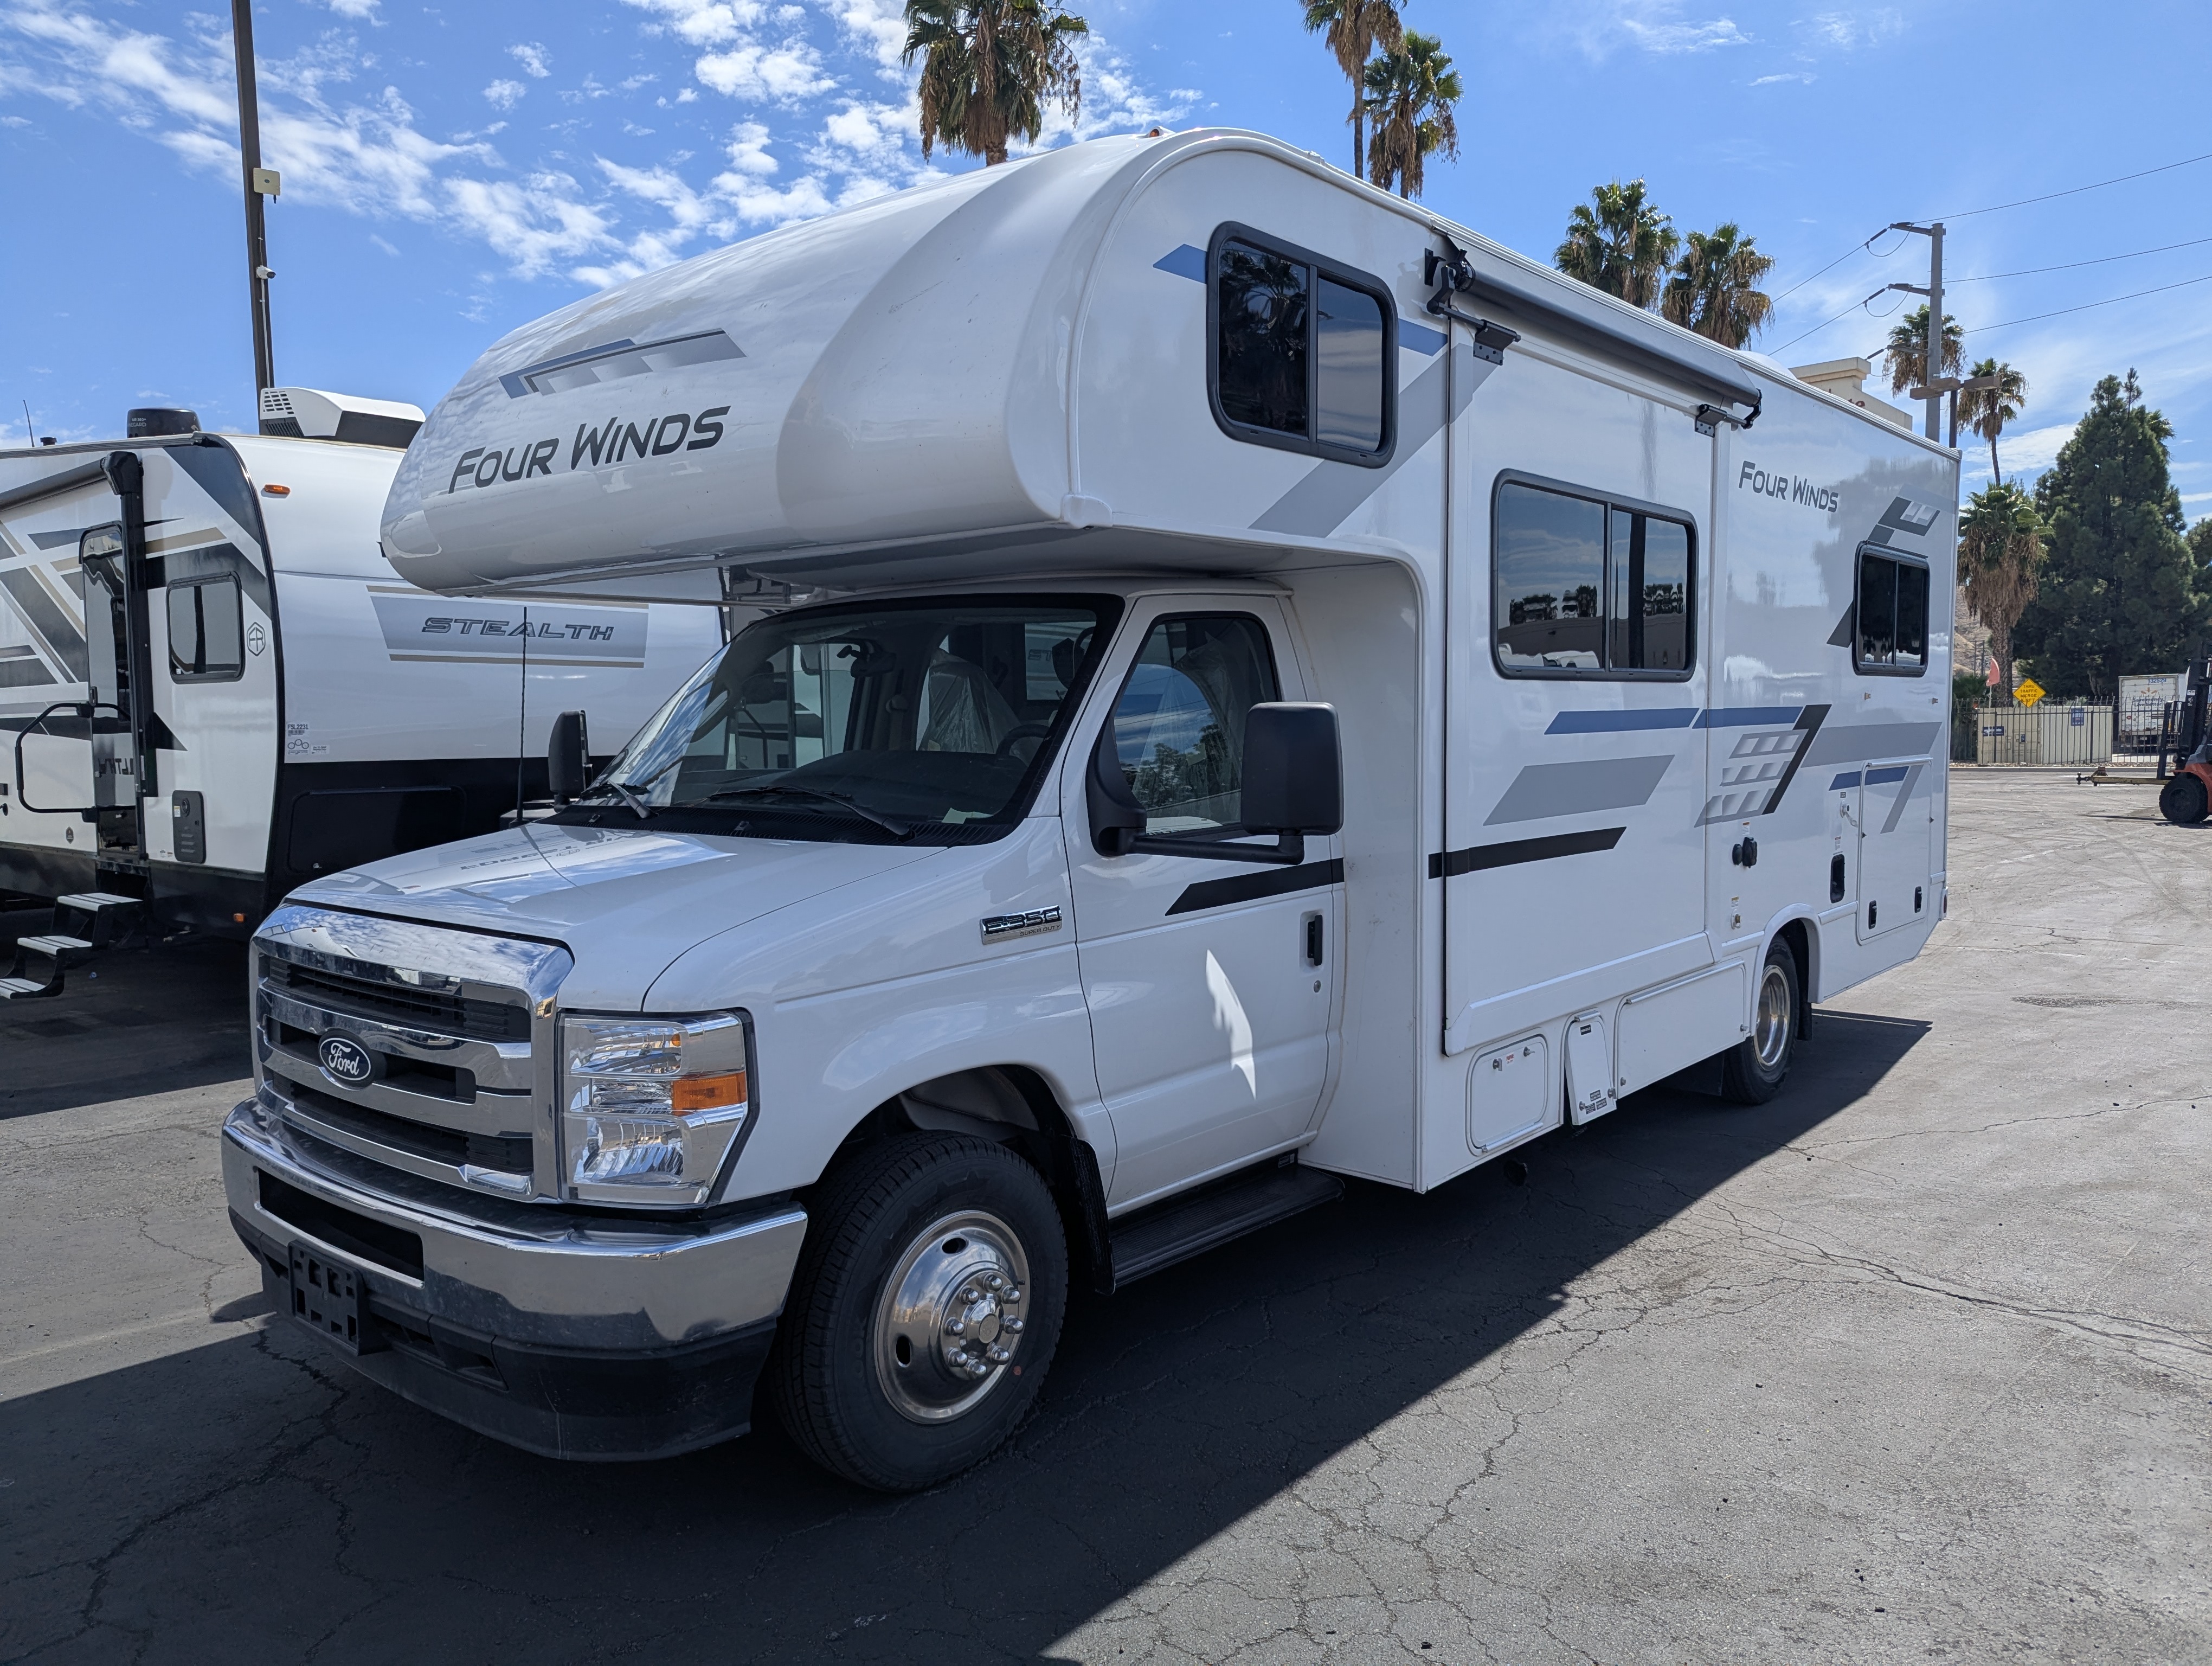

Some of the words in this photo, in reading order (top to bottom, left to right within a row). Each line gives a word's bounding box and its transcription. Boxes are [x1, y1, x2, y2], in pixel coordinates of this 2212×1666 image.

[448, 438, 560, 494] FOUR
[570, 406, 731, 470] WINDS
[1738, 460, 1788, 500] FOUR
[1792, 475, 1839, 513] WINDS
[422, 617, 614, 640] STEALTH
[1020, 928, 1041, 937] SUPER
[328, 1042, 360, 1075] Ford
